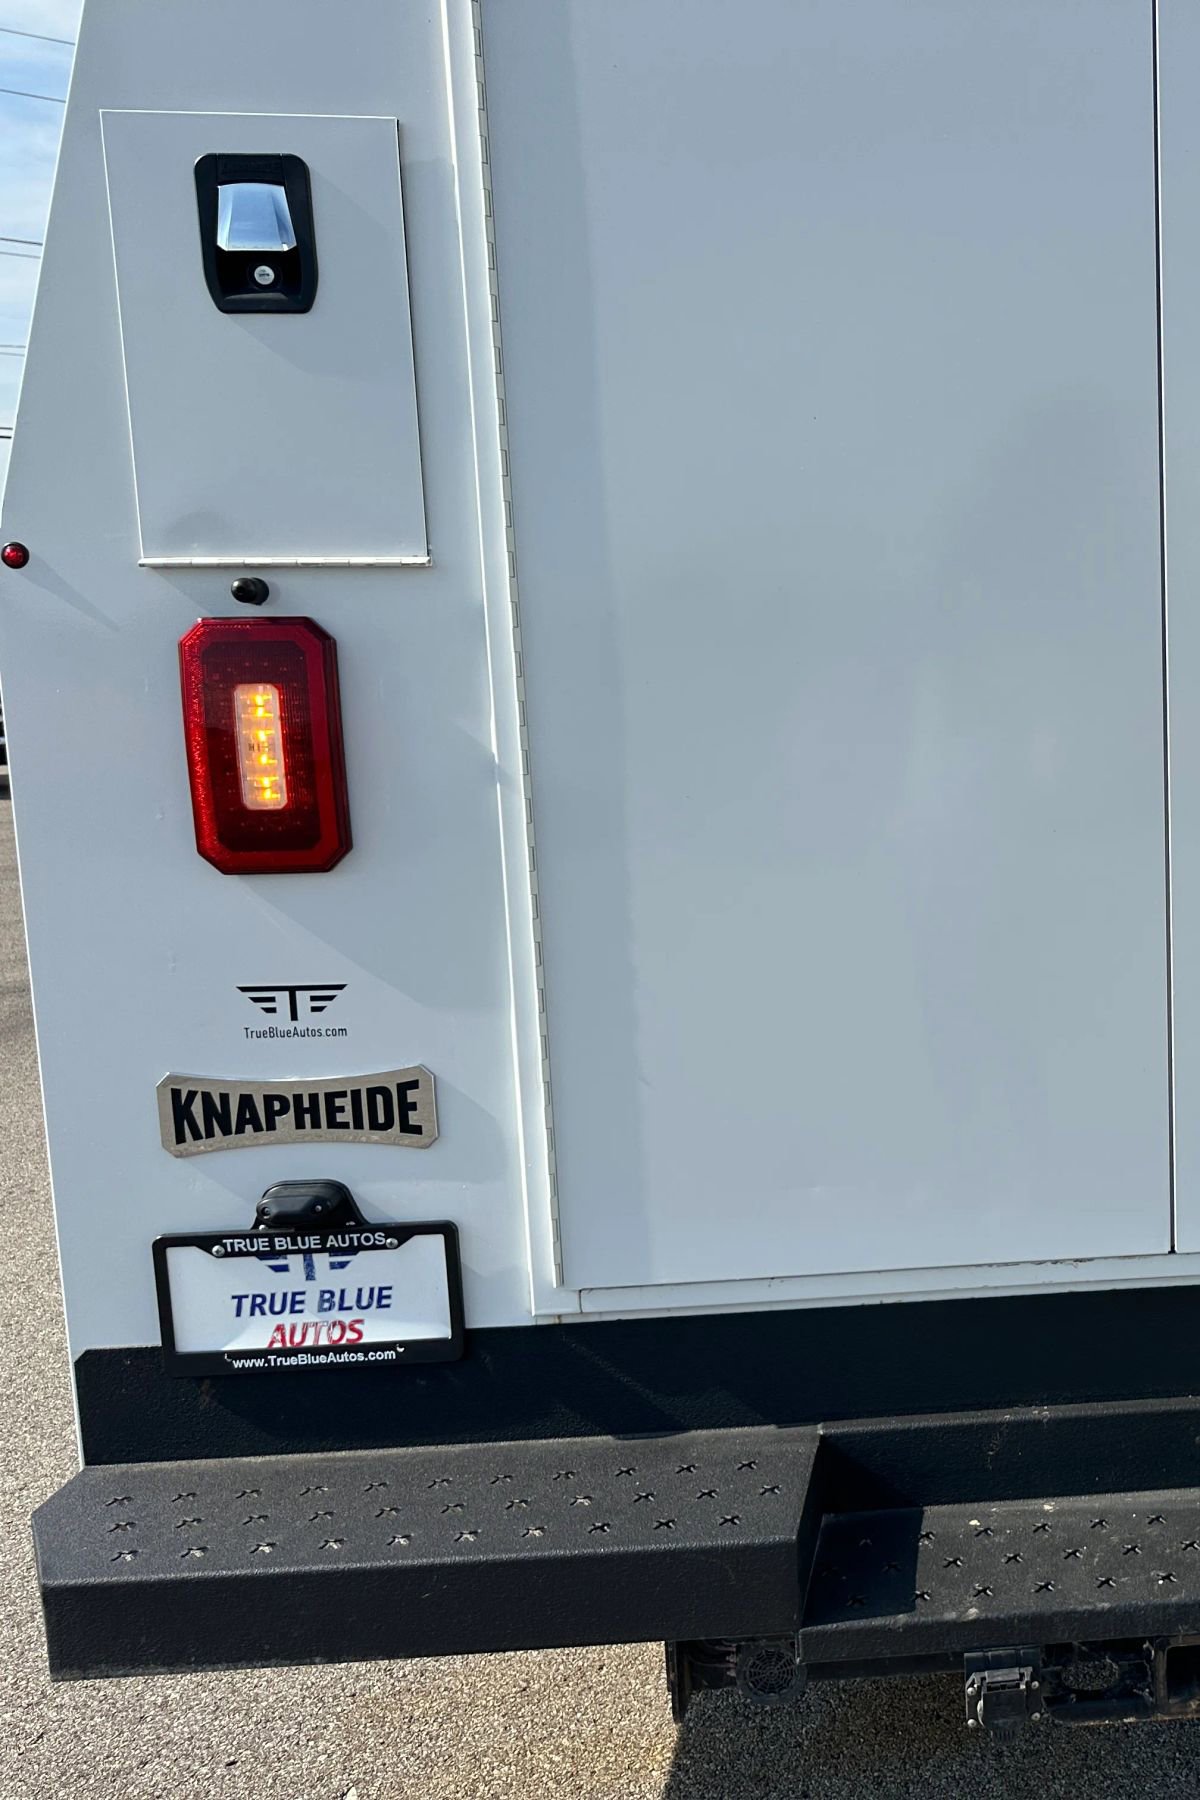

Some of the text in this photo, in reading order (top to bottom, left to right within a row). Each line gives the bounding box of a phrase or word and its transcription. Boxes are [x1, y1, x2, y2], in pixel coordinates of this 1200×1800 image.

[243, 1026, 348, 1040] TrueBlueAutos.com
[170, 1079, 423, 1145] KNAPHEIDE
[222, 1232, 386, 1252] TRUE BLUE AUTOS
[231, 1286, 393, 1317] TRUE BLUE
[266, 1318, 365, 1349] AUTOS
[232, 1350, 397, 1369] www.TrueBlueAutos.com
